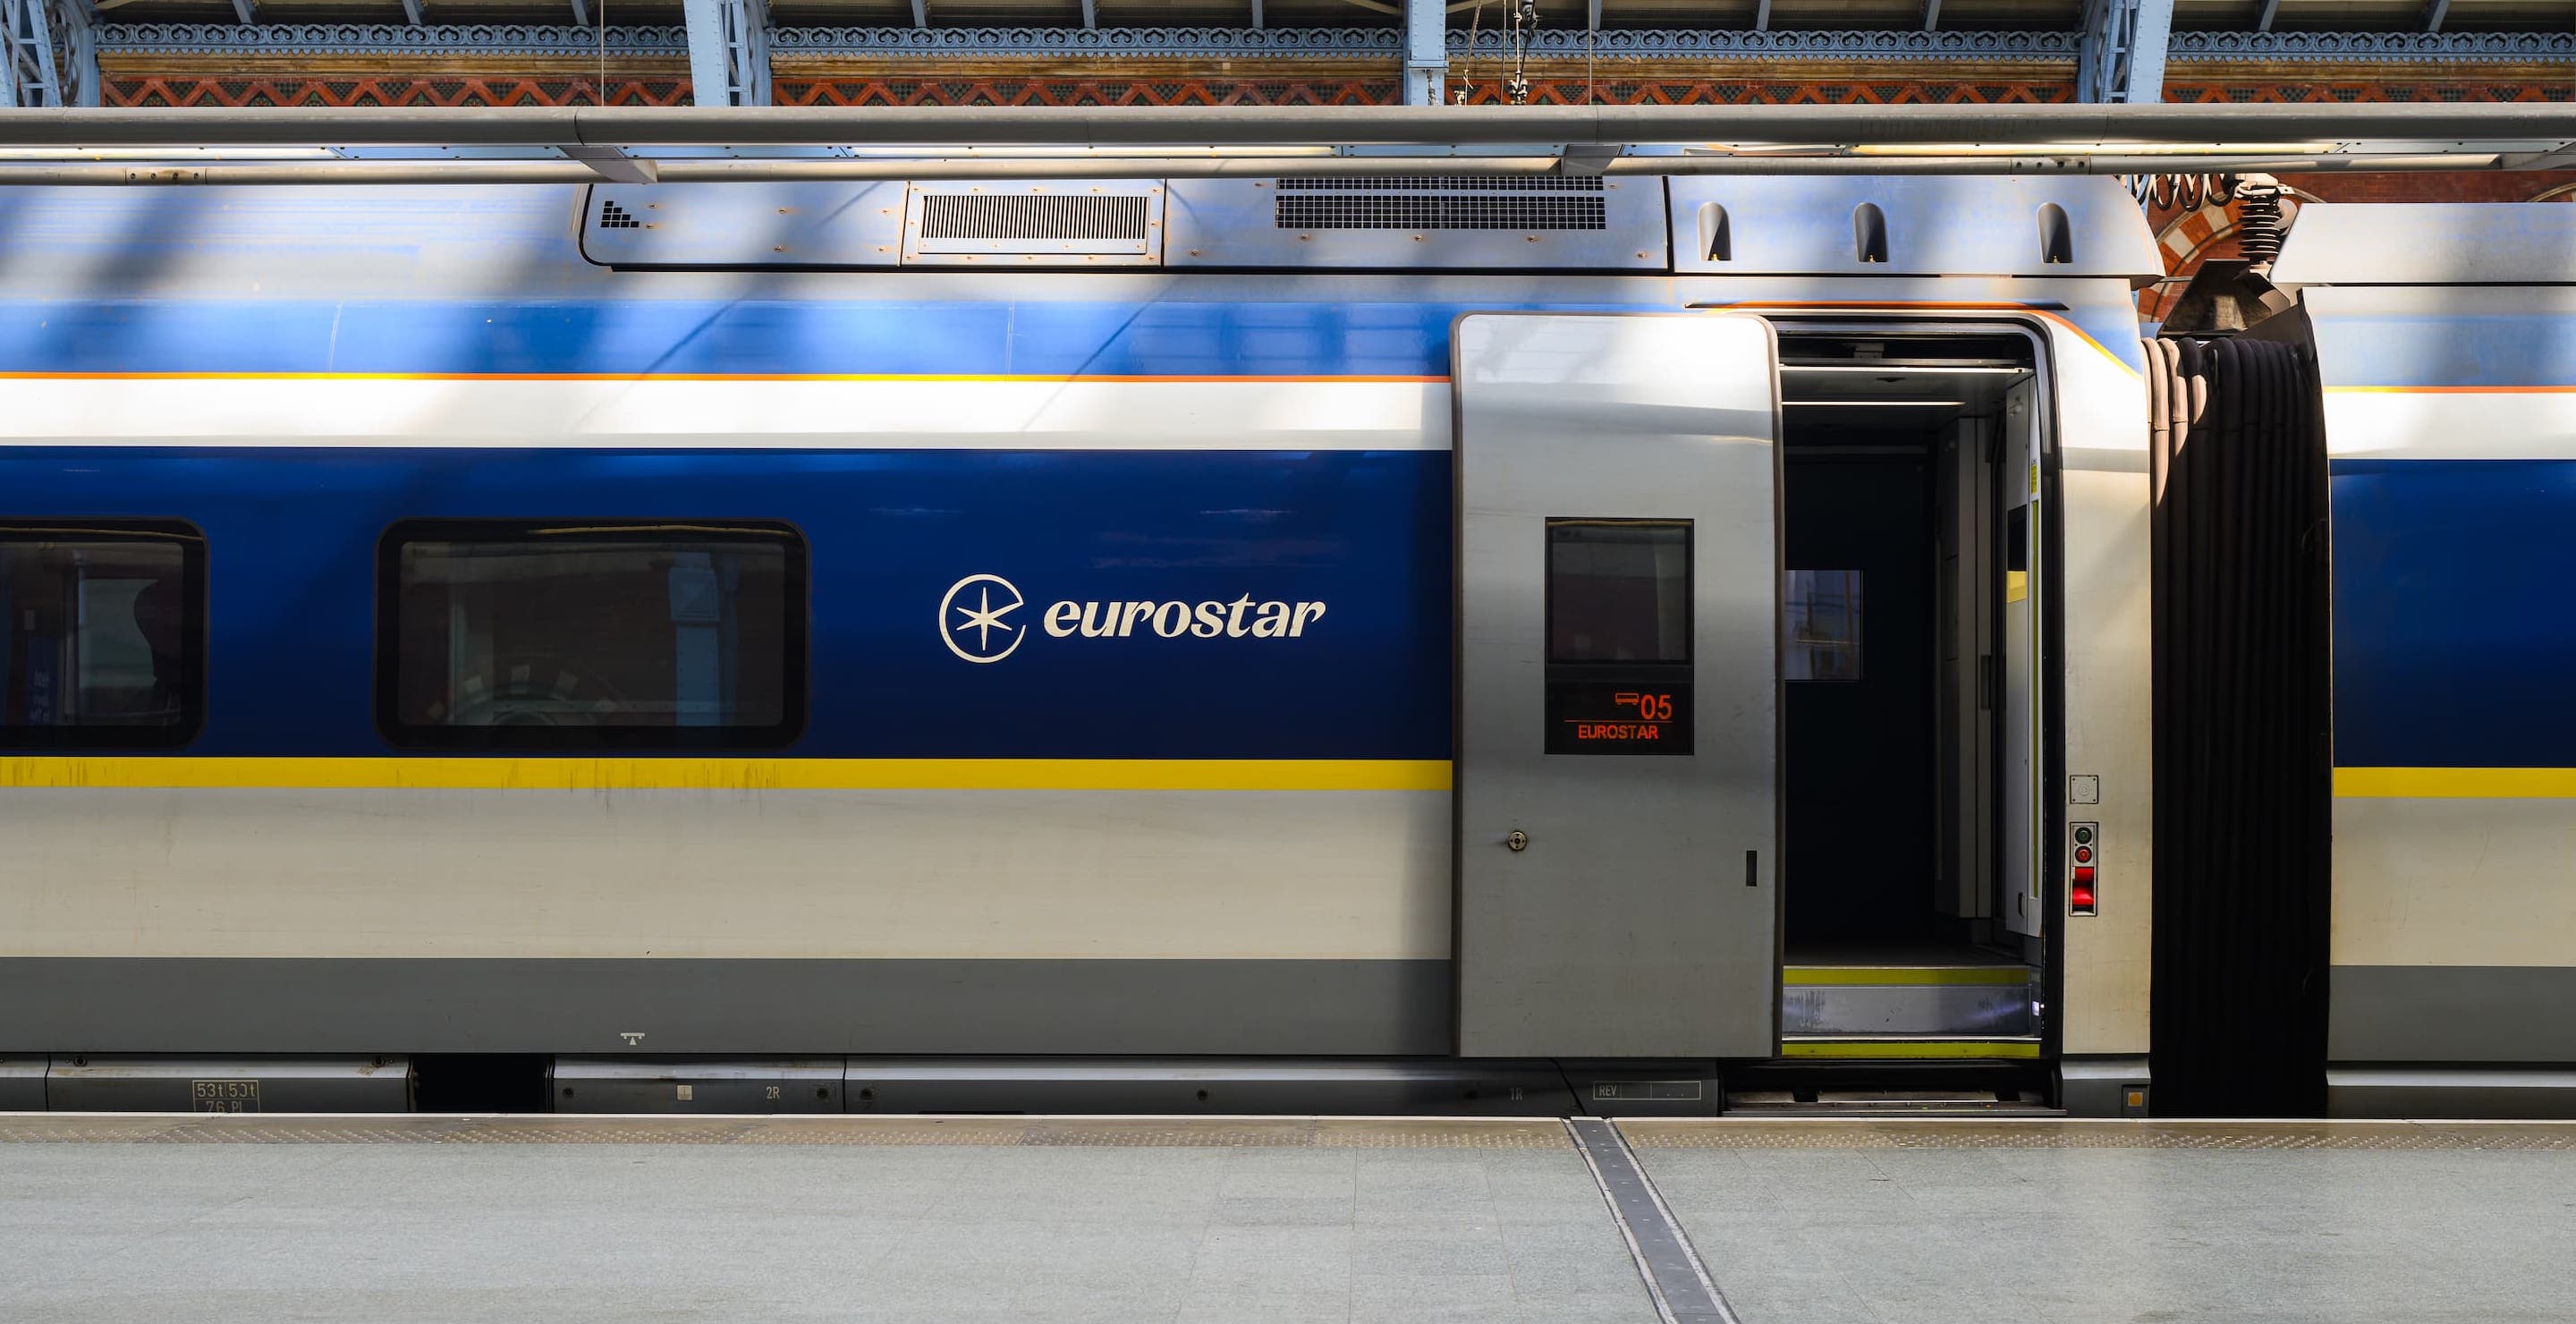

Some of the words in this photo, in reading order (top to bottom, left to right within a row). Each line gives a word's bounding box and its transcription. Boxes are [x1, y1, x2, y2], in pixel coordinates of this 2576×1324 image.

[1044, 593, 1326, 638] eurostar
[1641, 694, 1672, 719] 05
[1578, 725, 1658, 739] EUROSTAR
[766, 1086, 780, 1099] 2R
[1598, 1085, 1617, 1097] REV
